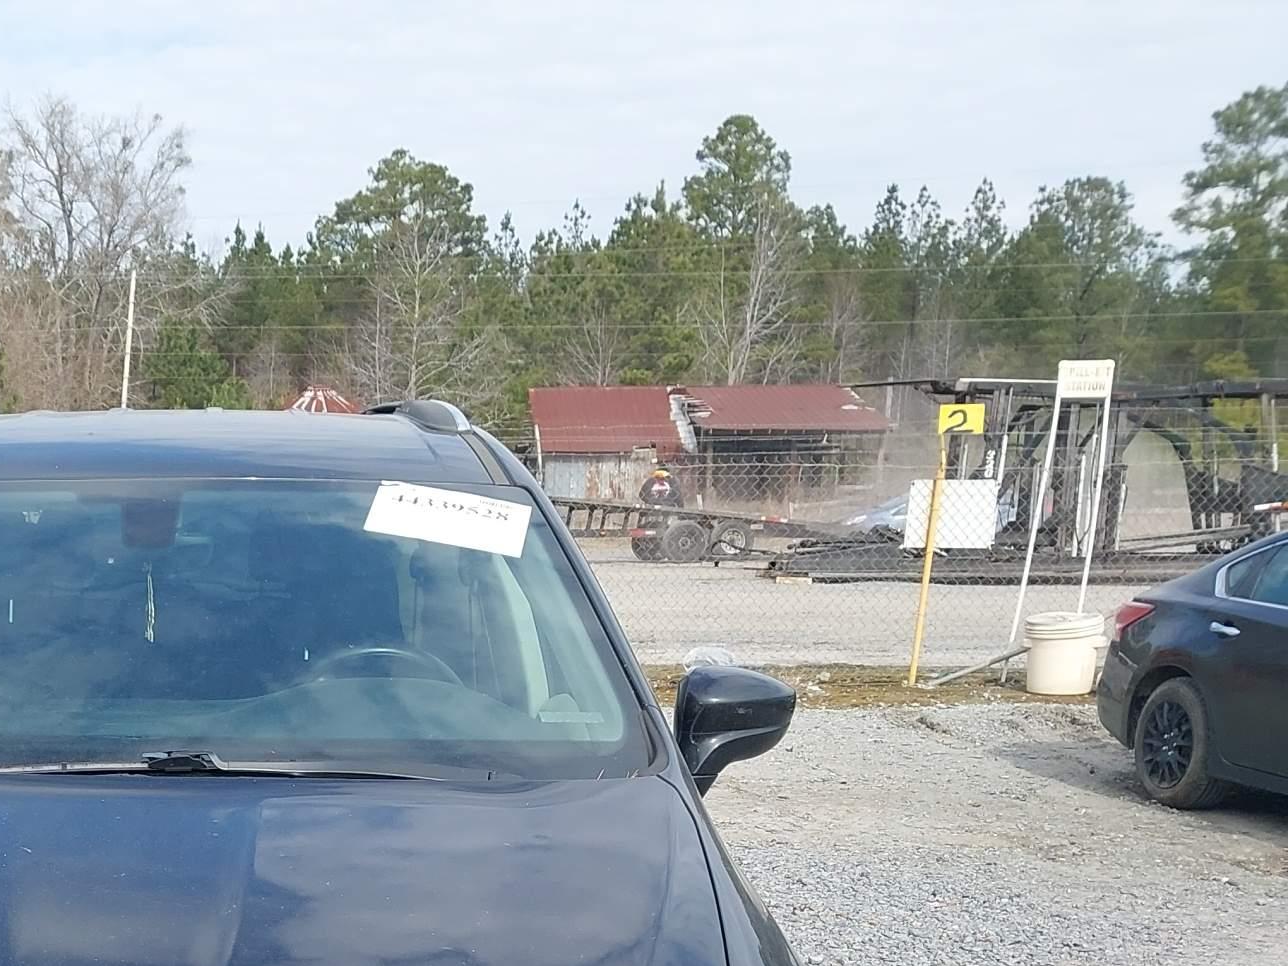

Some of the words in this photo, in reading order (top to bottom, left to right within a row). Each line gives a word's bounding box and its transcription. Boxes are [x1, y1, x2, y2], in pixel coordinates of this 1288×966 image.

[1064, 366, 1111, 377] PILL-T
[1064, 381, 1105, 391] STATION
[943, 409, 974, 433] 2
